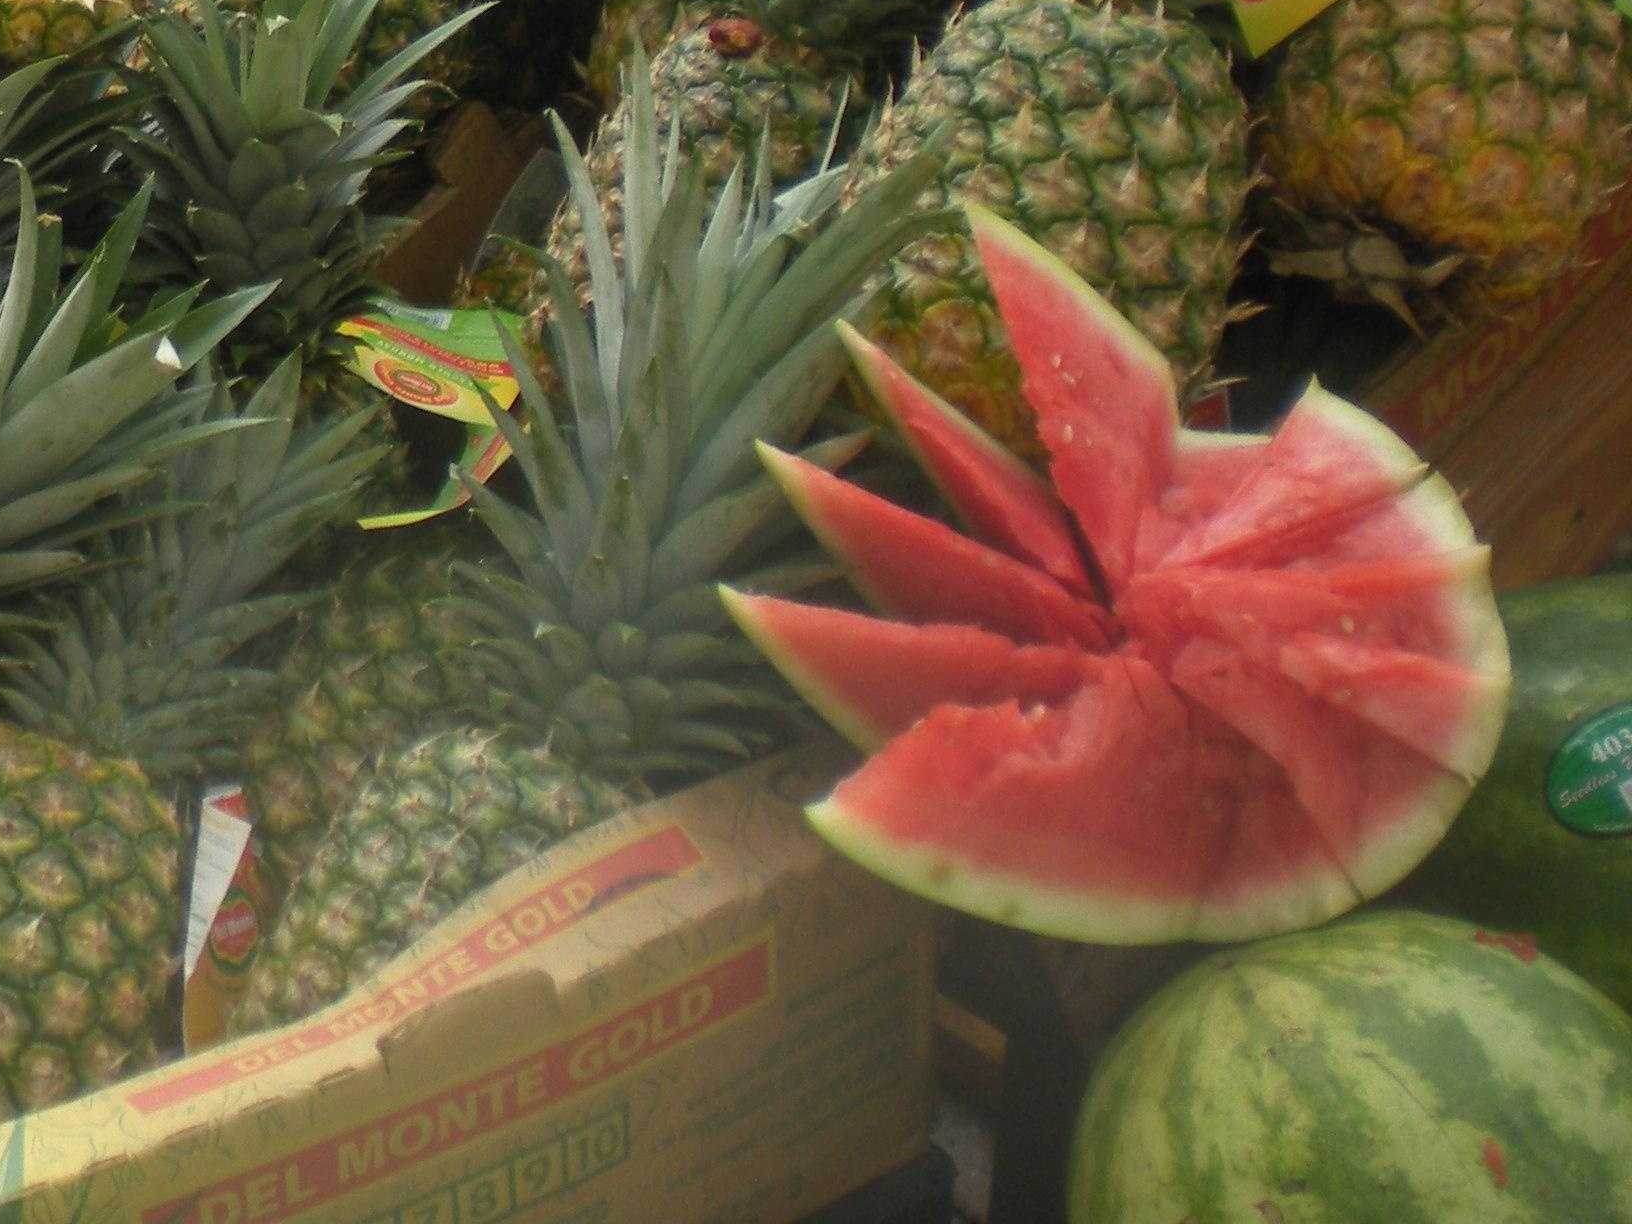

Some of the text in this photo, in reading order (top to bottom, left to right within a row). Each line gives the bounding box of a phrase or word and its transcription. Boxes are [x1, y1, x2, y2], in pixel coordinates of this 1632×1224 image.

[233, 879, 595, 1073] DEL MONTE GOLD
[197, 1164, 317, 1224] DEL
[336, 1059, 546, 1180] MONTE
[569, 982, 714, 1080] GOLD
